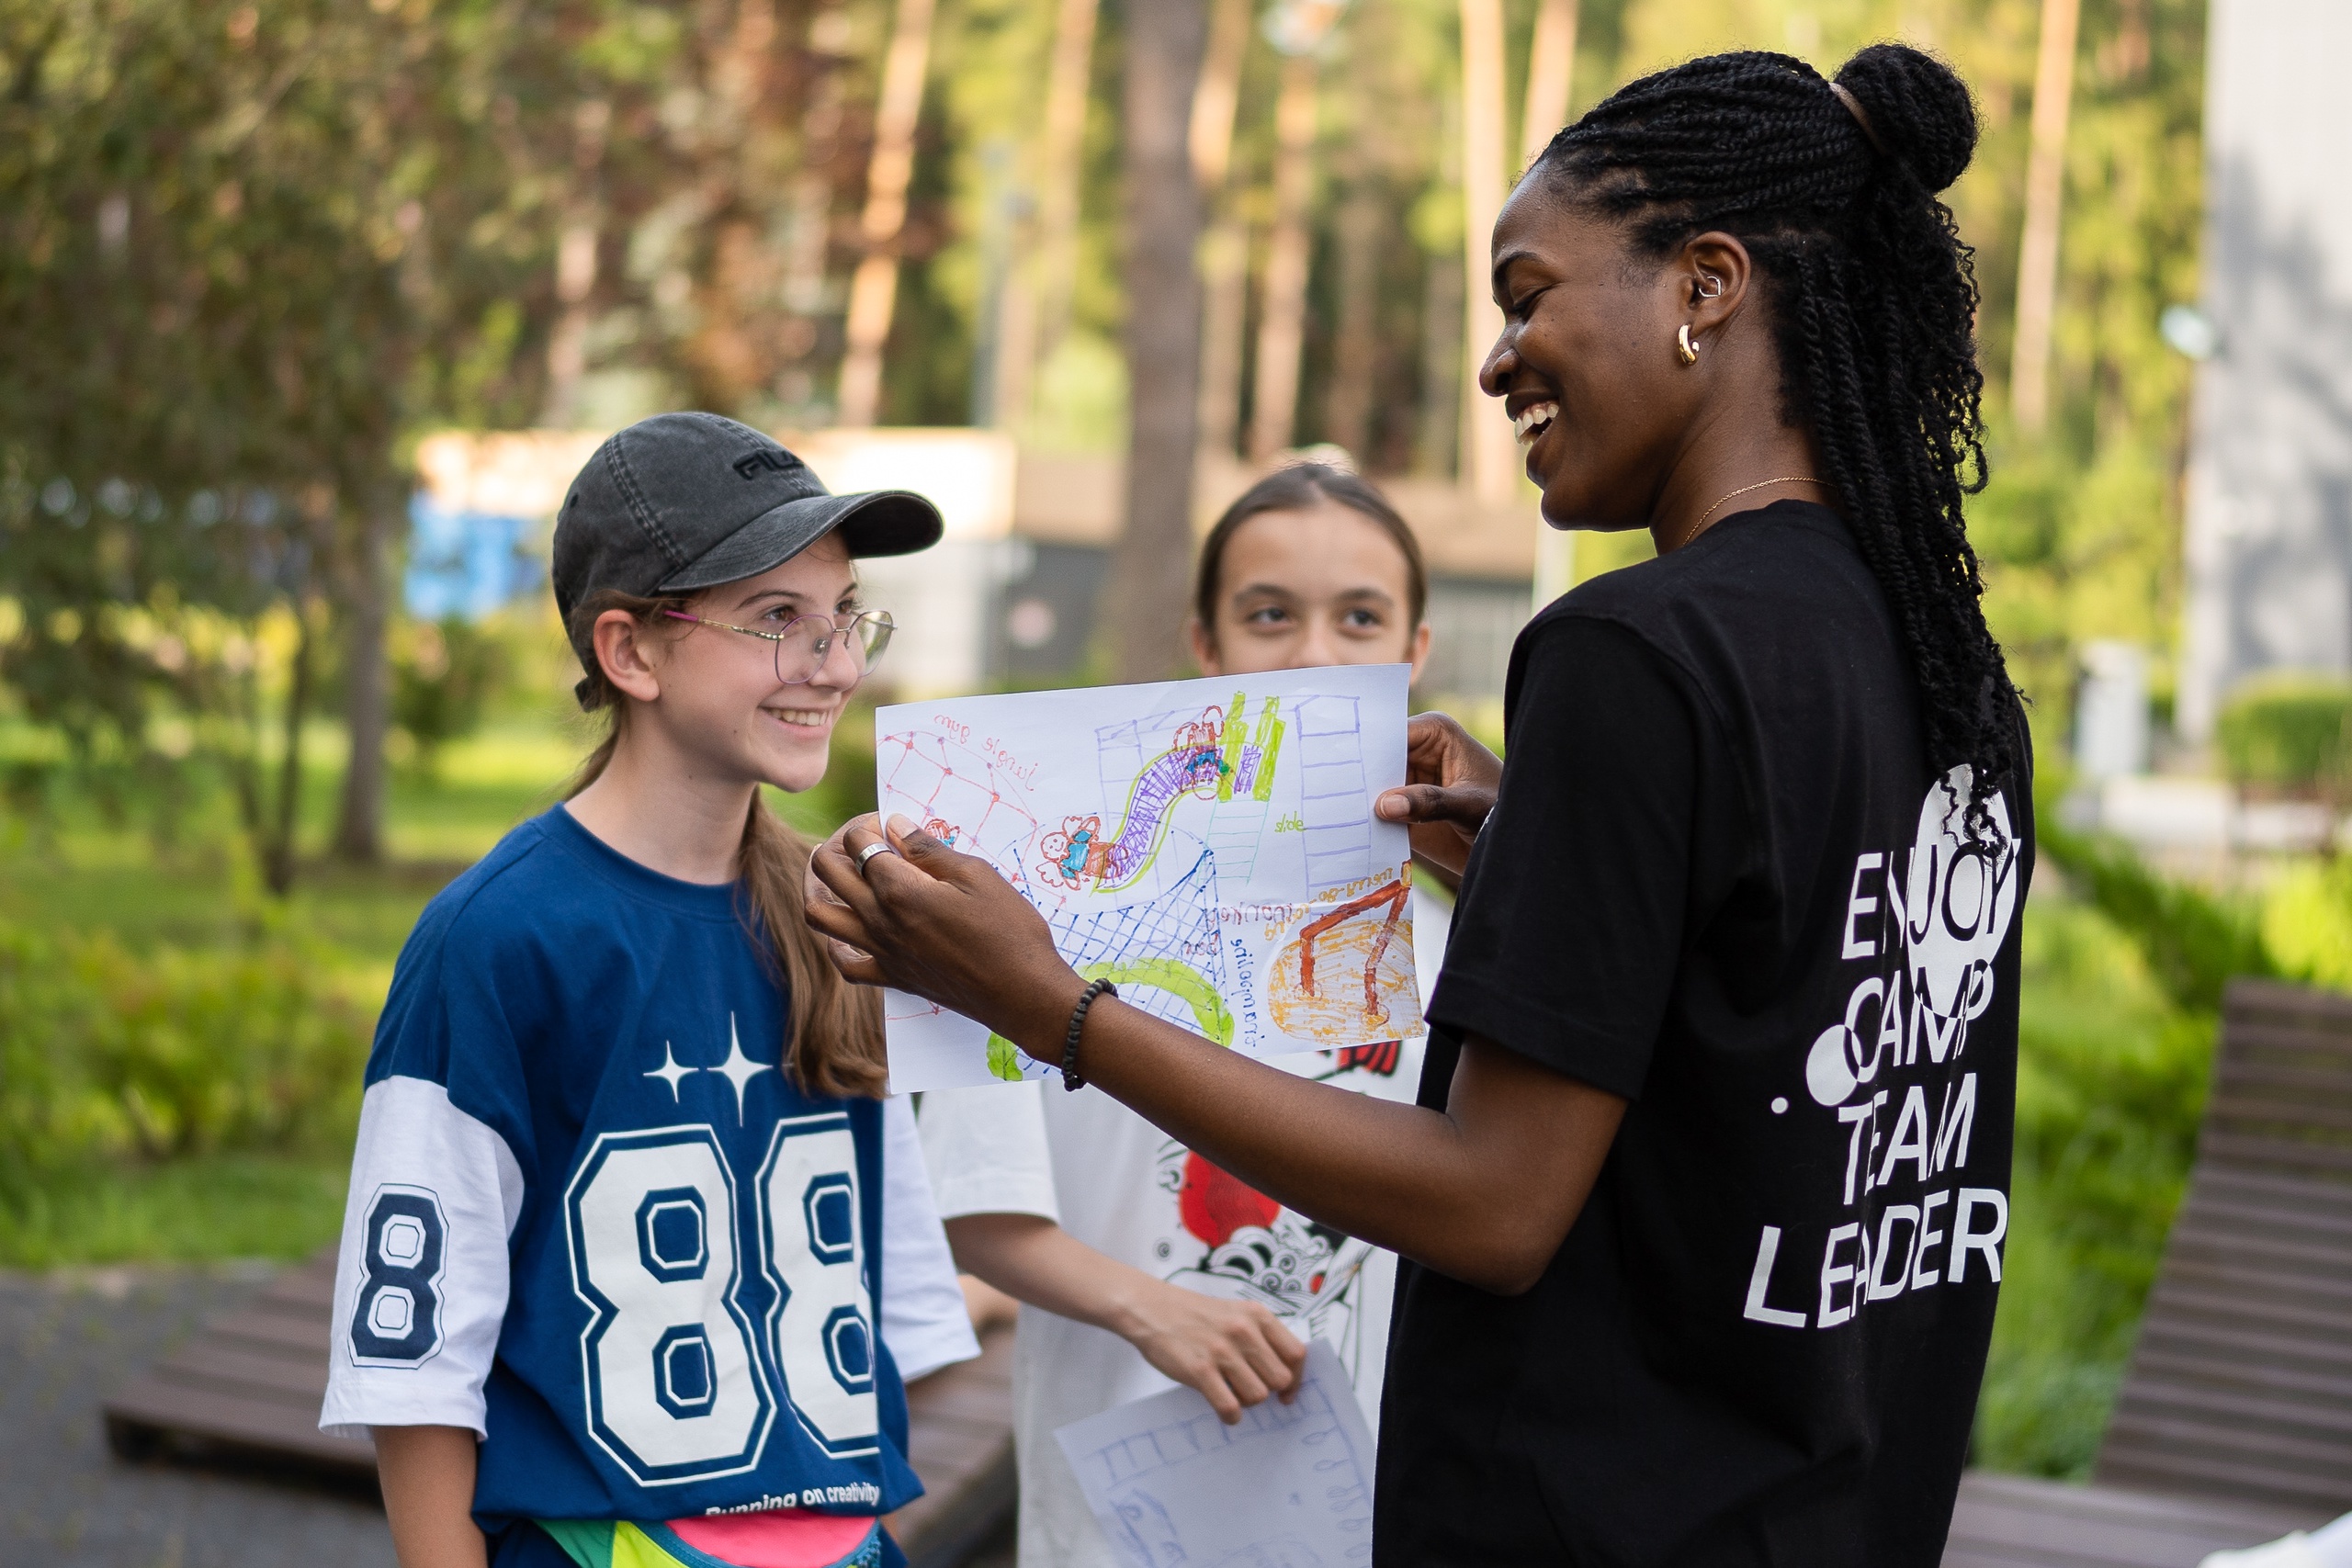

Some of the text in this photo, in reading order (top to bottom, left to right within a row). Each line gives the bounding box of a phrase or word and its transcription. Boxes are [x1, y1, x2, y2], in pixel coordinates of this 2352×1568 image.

[1274, 810, 1306, 833] slide
[1841, 838, 2021, 959] ENJOY
[1842, 958, 1994, 1084] CAMP
[1838, 1073, 1977, 1205] TEAM
[347, 1183, 450, 1370] 8
[564, 1111, 880, 1488] 88
[1743, 1188, 2008, 1328] LEADER
[802, 1487, 826, 1506] on
[827, 1482, 880, 1506] creativity
